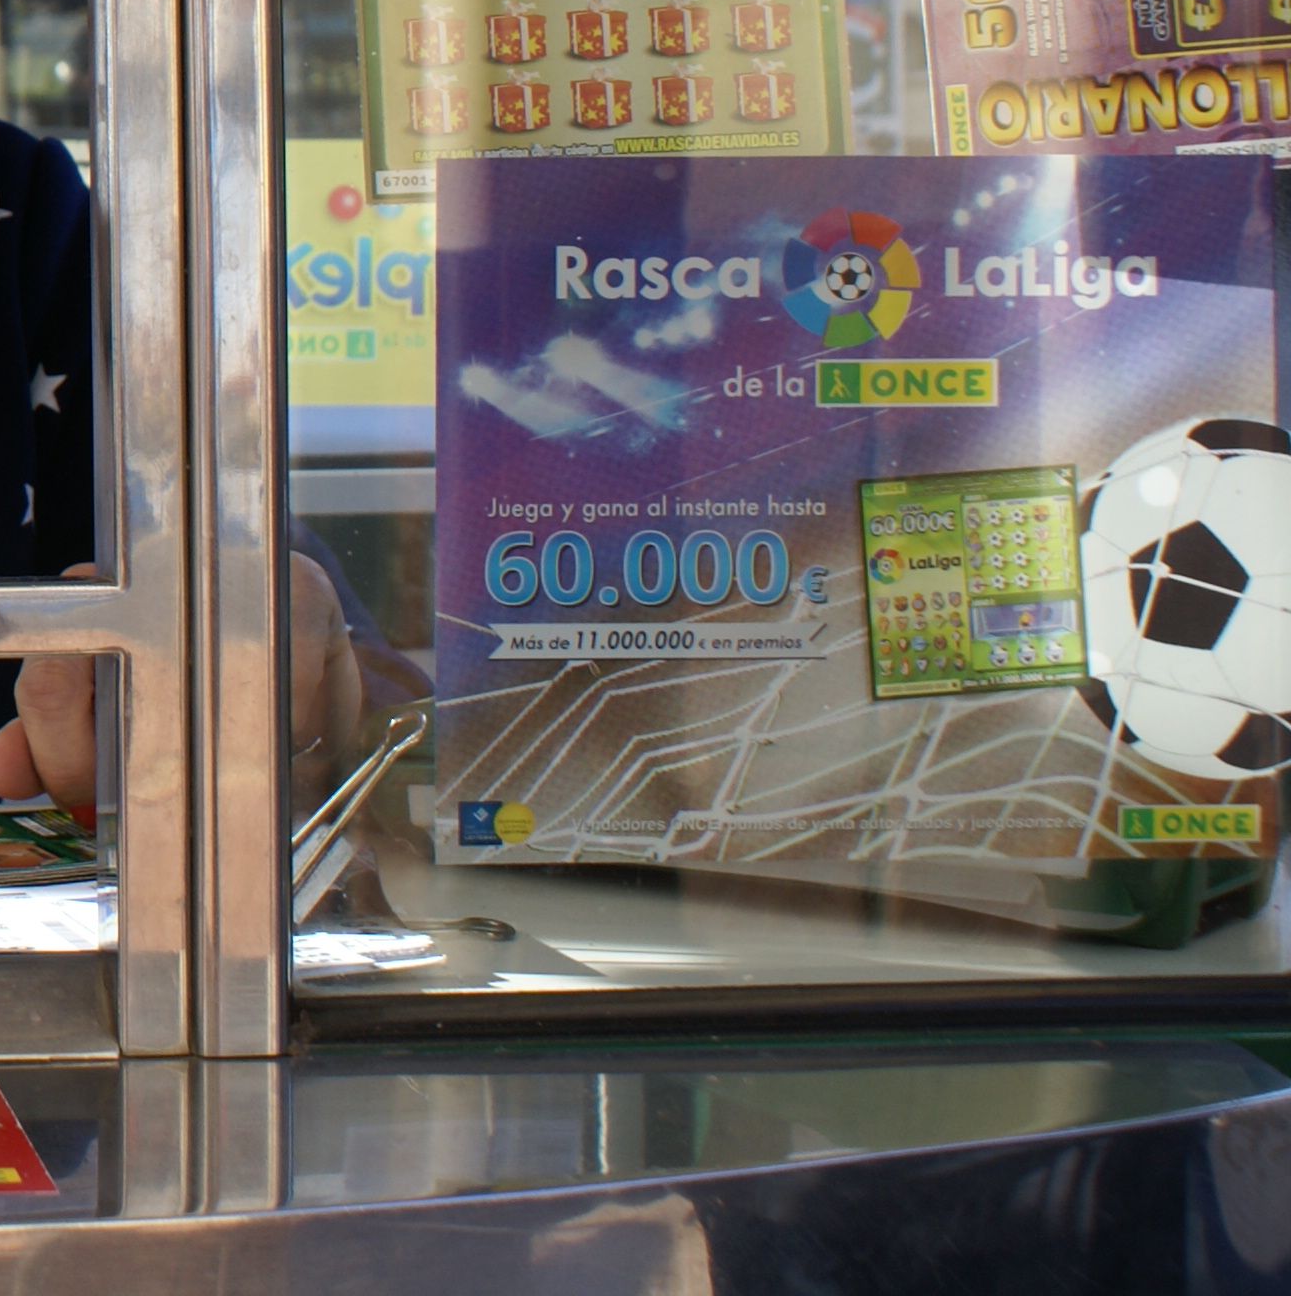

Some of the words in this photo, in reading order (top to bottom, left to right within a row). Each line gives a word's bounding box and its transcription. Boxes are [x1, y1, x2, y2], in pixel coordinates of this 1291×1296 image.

[617, 132, 799, 154] WWW.RASCADENAVIDAD.ES
[556, 245, 761, 299] Rasca
[944, 242, 1158, 309] LaLiga
[724, 366, 761, 398] de
[775, 366, 806, 398] la
[870, 368, 986, 398] ONCE
[487, 497, 549, 522] Juega
[560, 501, 574, 522] y
[582, 501, 638, 522] gana
[648, 497, 667, 518] al
[675, 495, 759, 518] instante
[769, 495, 827, 518] hasta
[486, 529, 791, 608] 60.000
[798, 564, 830, 605] €
[511, 634, 544, 651] Más
[550, 634, 571, 651] de
[575, 628, 694, 654] 11.000.000
[712, 638, 735, 651] en
[740, 634, 803, 655] premios
[1160, 809, 1253, 838] ONCE
